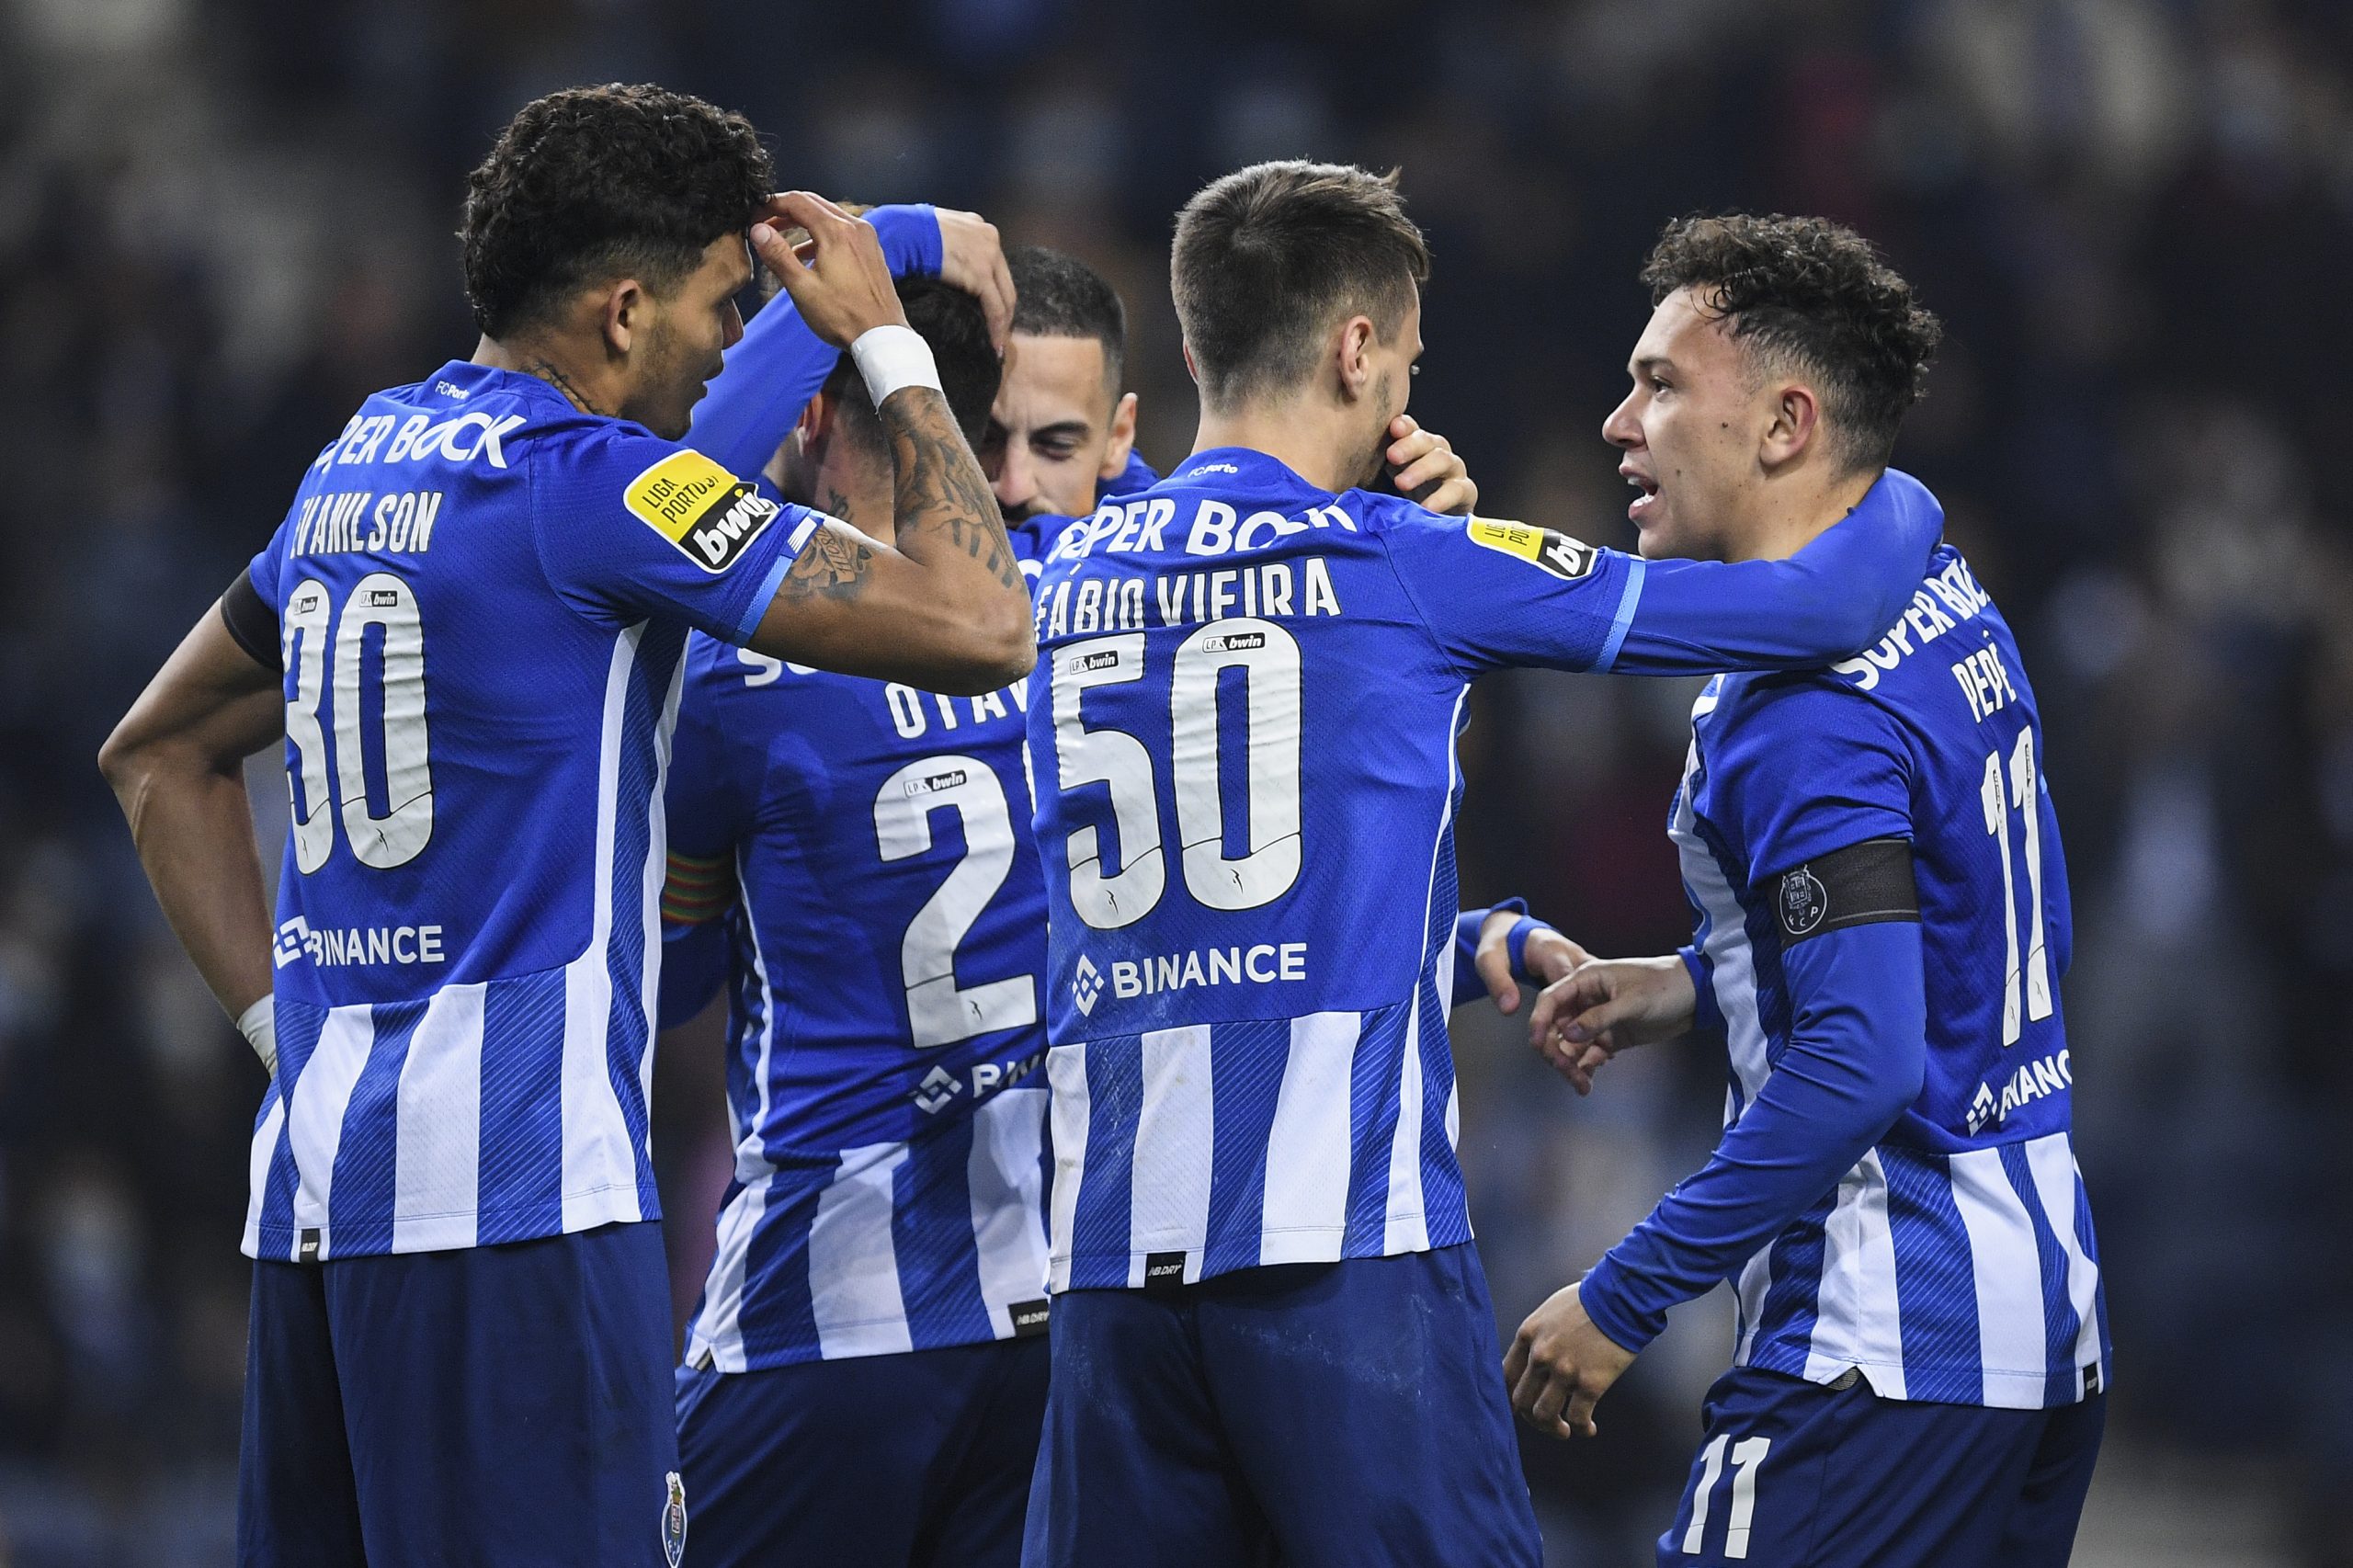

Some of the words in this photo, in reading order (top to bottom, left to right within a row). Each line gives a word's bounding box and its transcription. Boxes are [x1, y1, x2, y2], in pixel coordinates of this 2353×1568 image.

[383, 412, 528, 470] BOCK
[642, 477, 679, 509] LIGA
[1156, 556, 1342, 629] VIEIRA
[1088, 653, 1117, 669] bwin
[1229, 635, 1263, 650] bwin
[282, 572, 435, 876] 30
[932, 772, 965, 791] bwin
[1051, 617, 1302, 930] 50
[872, 739, 1037, 1049] 2
[1980, 725, 2053, 1047] 11
[310, 925, 446, 967] BINANCE
[1112, 942, 1308, 999] BINANCE
[1160, 1264, 1182, 1276] DRY
[1682, 1433, 1770, 1560] 11
